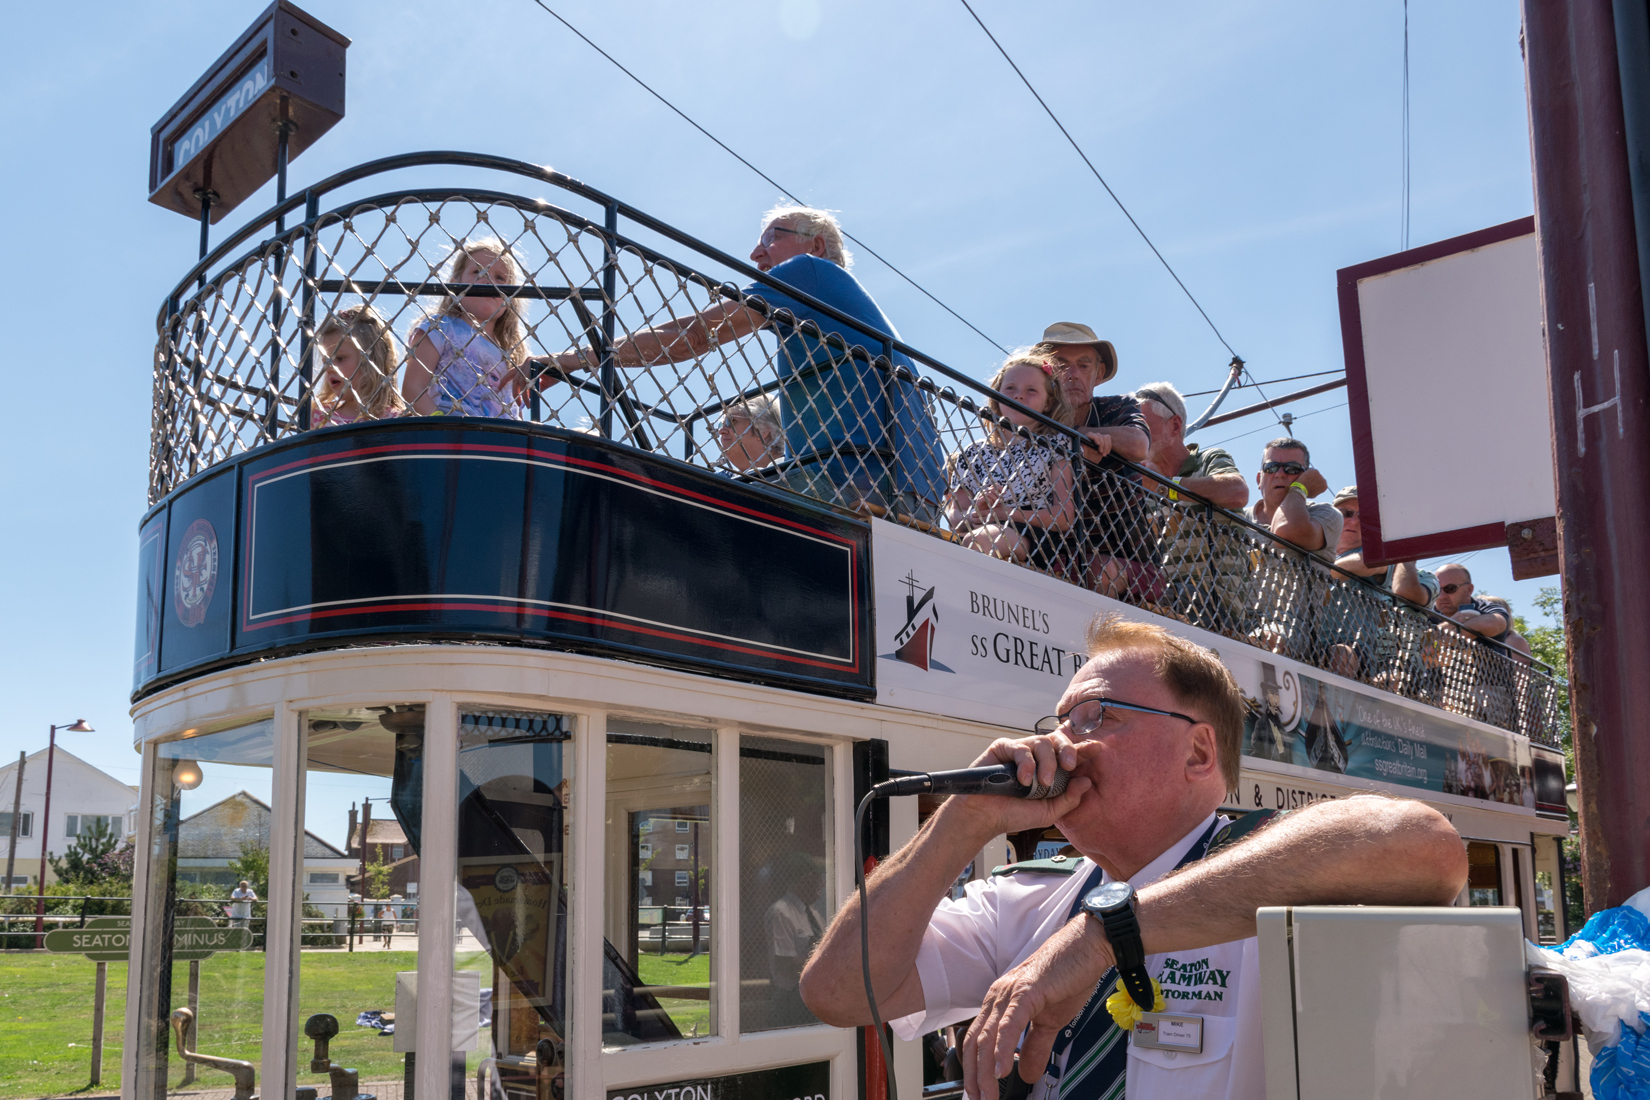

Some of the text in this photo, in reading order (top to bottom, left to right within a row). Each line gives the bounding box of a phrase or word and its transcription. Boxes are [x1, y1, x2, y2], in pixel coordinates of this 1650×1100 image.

[178, 65, 268, 167] COLYTON
[969, 590, 1050, 635] BRUNEL'S
[993, 632, 1066, 677] GREAT
[1397, 738, 1414, 760] Daily
[1414, 743, 1428, 760] Mail
[1374, 758, 1428, 784] ssgreatbritain.org
[1253, 783, 1263, 807] &
[174, 933, 226, 946] MINUS
[1163, 957, 1210, 973] SEATON
[1069, 1005, 1086, 1029] london
[1085, 977, 1104, 1008] transport
